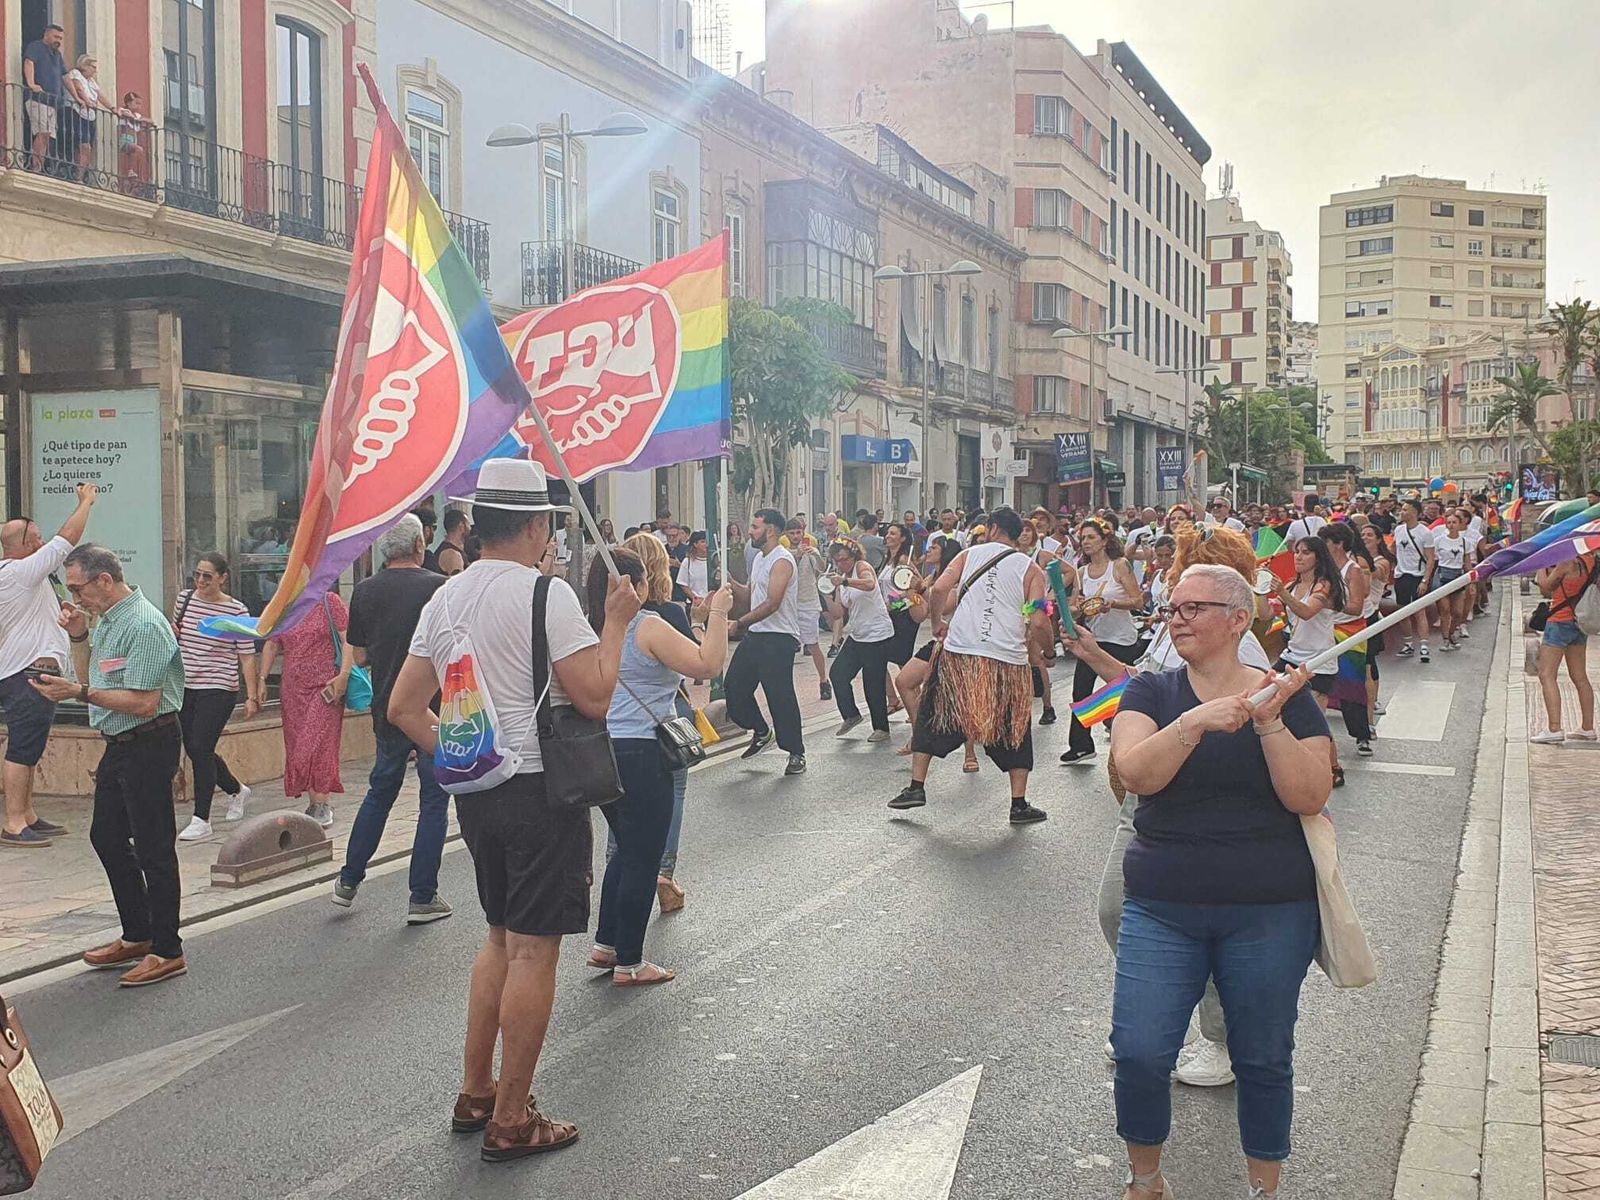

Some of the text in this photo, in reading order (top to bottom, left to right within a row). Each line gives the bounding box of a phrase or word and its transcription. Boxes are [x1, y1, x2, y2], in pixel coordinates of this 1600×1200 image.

[42, 405, 53, 419] la
[59, 405, 93, 421] plaza
[42, 440, 128, 453] ¿Qué tipo de pan
[1058, 433, 1087, 448] XXIII
[42, 453, 122, 467] te apetece hoy?
[1159, 450, 1182, 461] XXIII
[42, 469, 102, 481] ¿Lo quieres
[42, 484, 74, 494] recién
